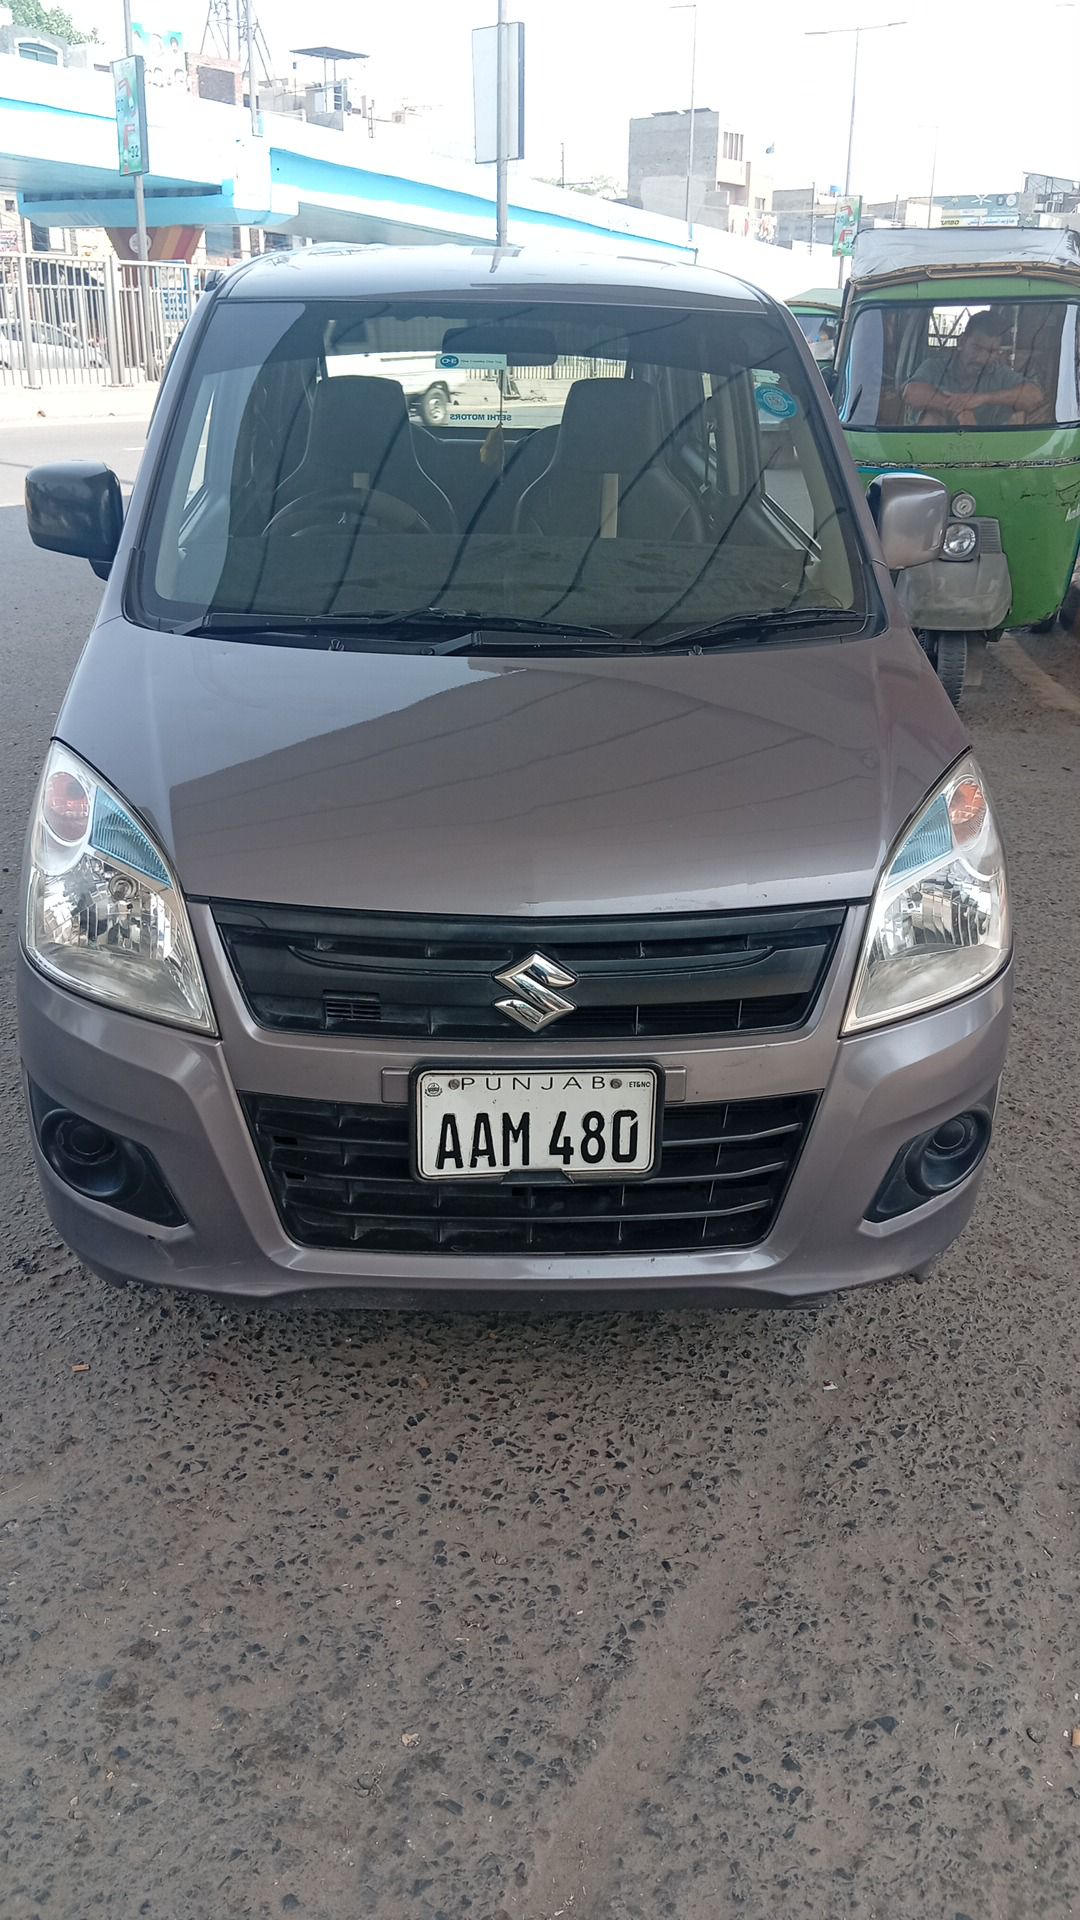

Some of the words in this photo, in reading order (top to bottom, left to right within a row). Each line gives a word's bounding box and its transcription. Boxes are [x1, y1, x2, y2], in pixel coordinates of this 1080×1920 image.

[461, 1076, 606, 1091] PUNJAB
[435, 1112, 530, 1170] AAM
[549, 1109, 639, 1165] 480
